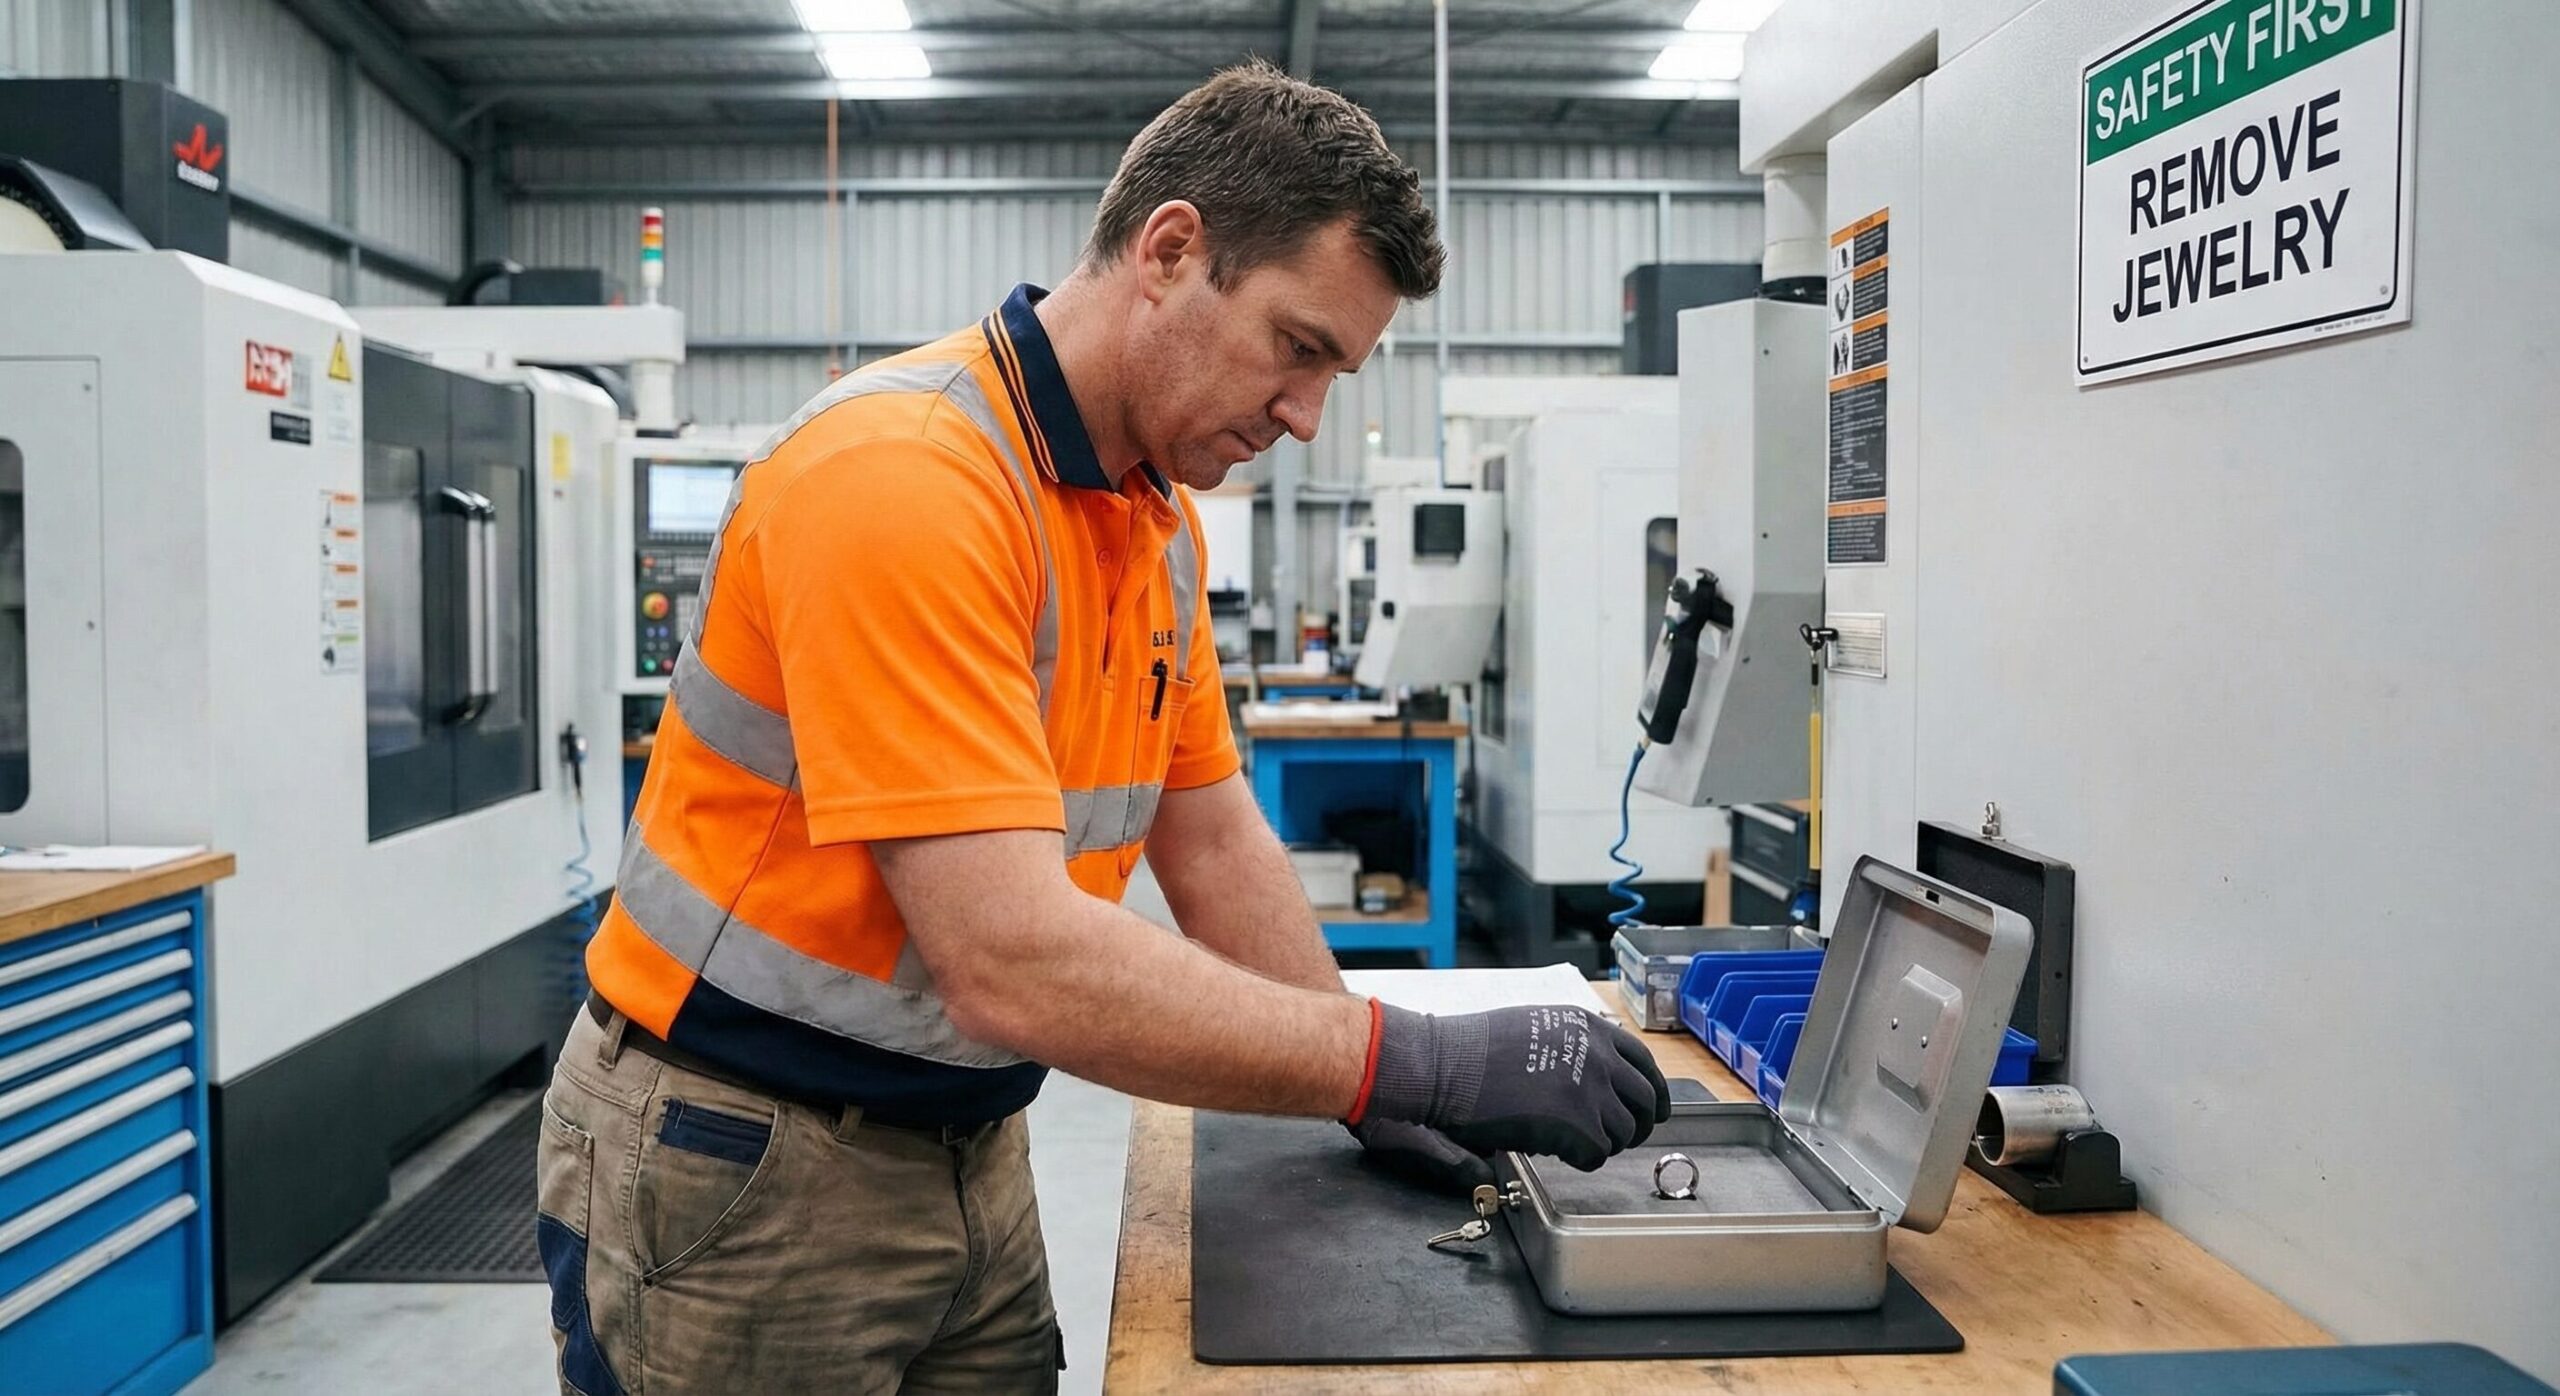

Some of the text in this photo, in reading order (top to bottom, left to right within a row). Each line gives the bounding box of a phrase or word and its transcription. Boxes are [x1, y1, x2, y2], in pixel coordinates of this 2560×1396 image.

[2095, 0, 2371, 140] SAFETY FIRS
[2130, 89, 2341, 235] REMOVE
[2113, 188, 2350, 323] JEWELRY
